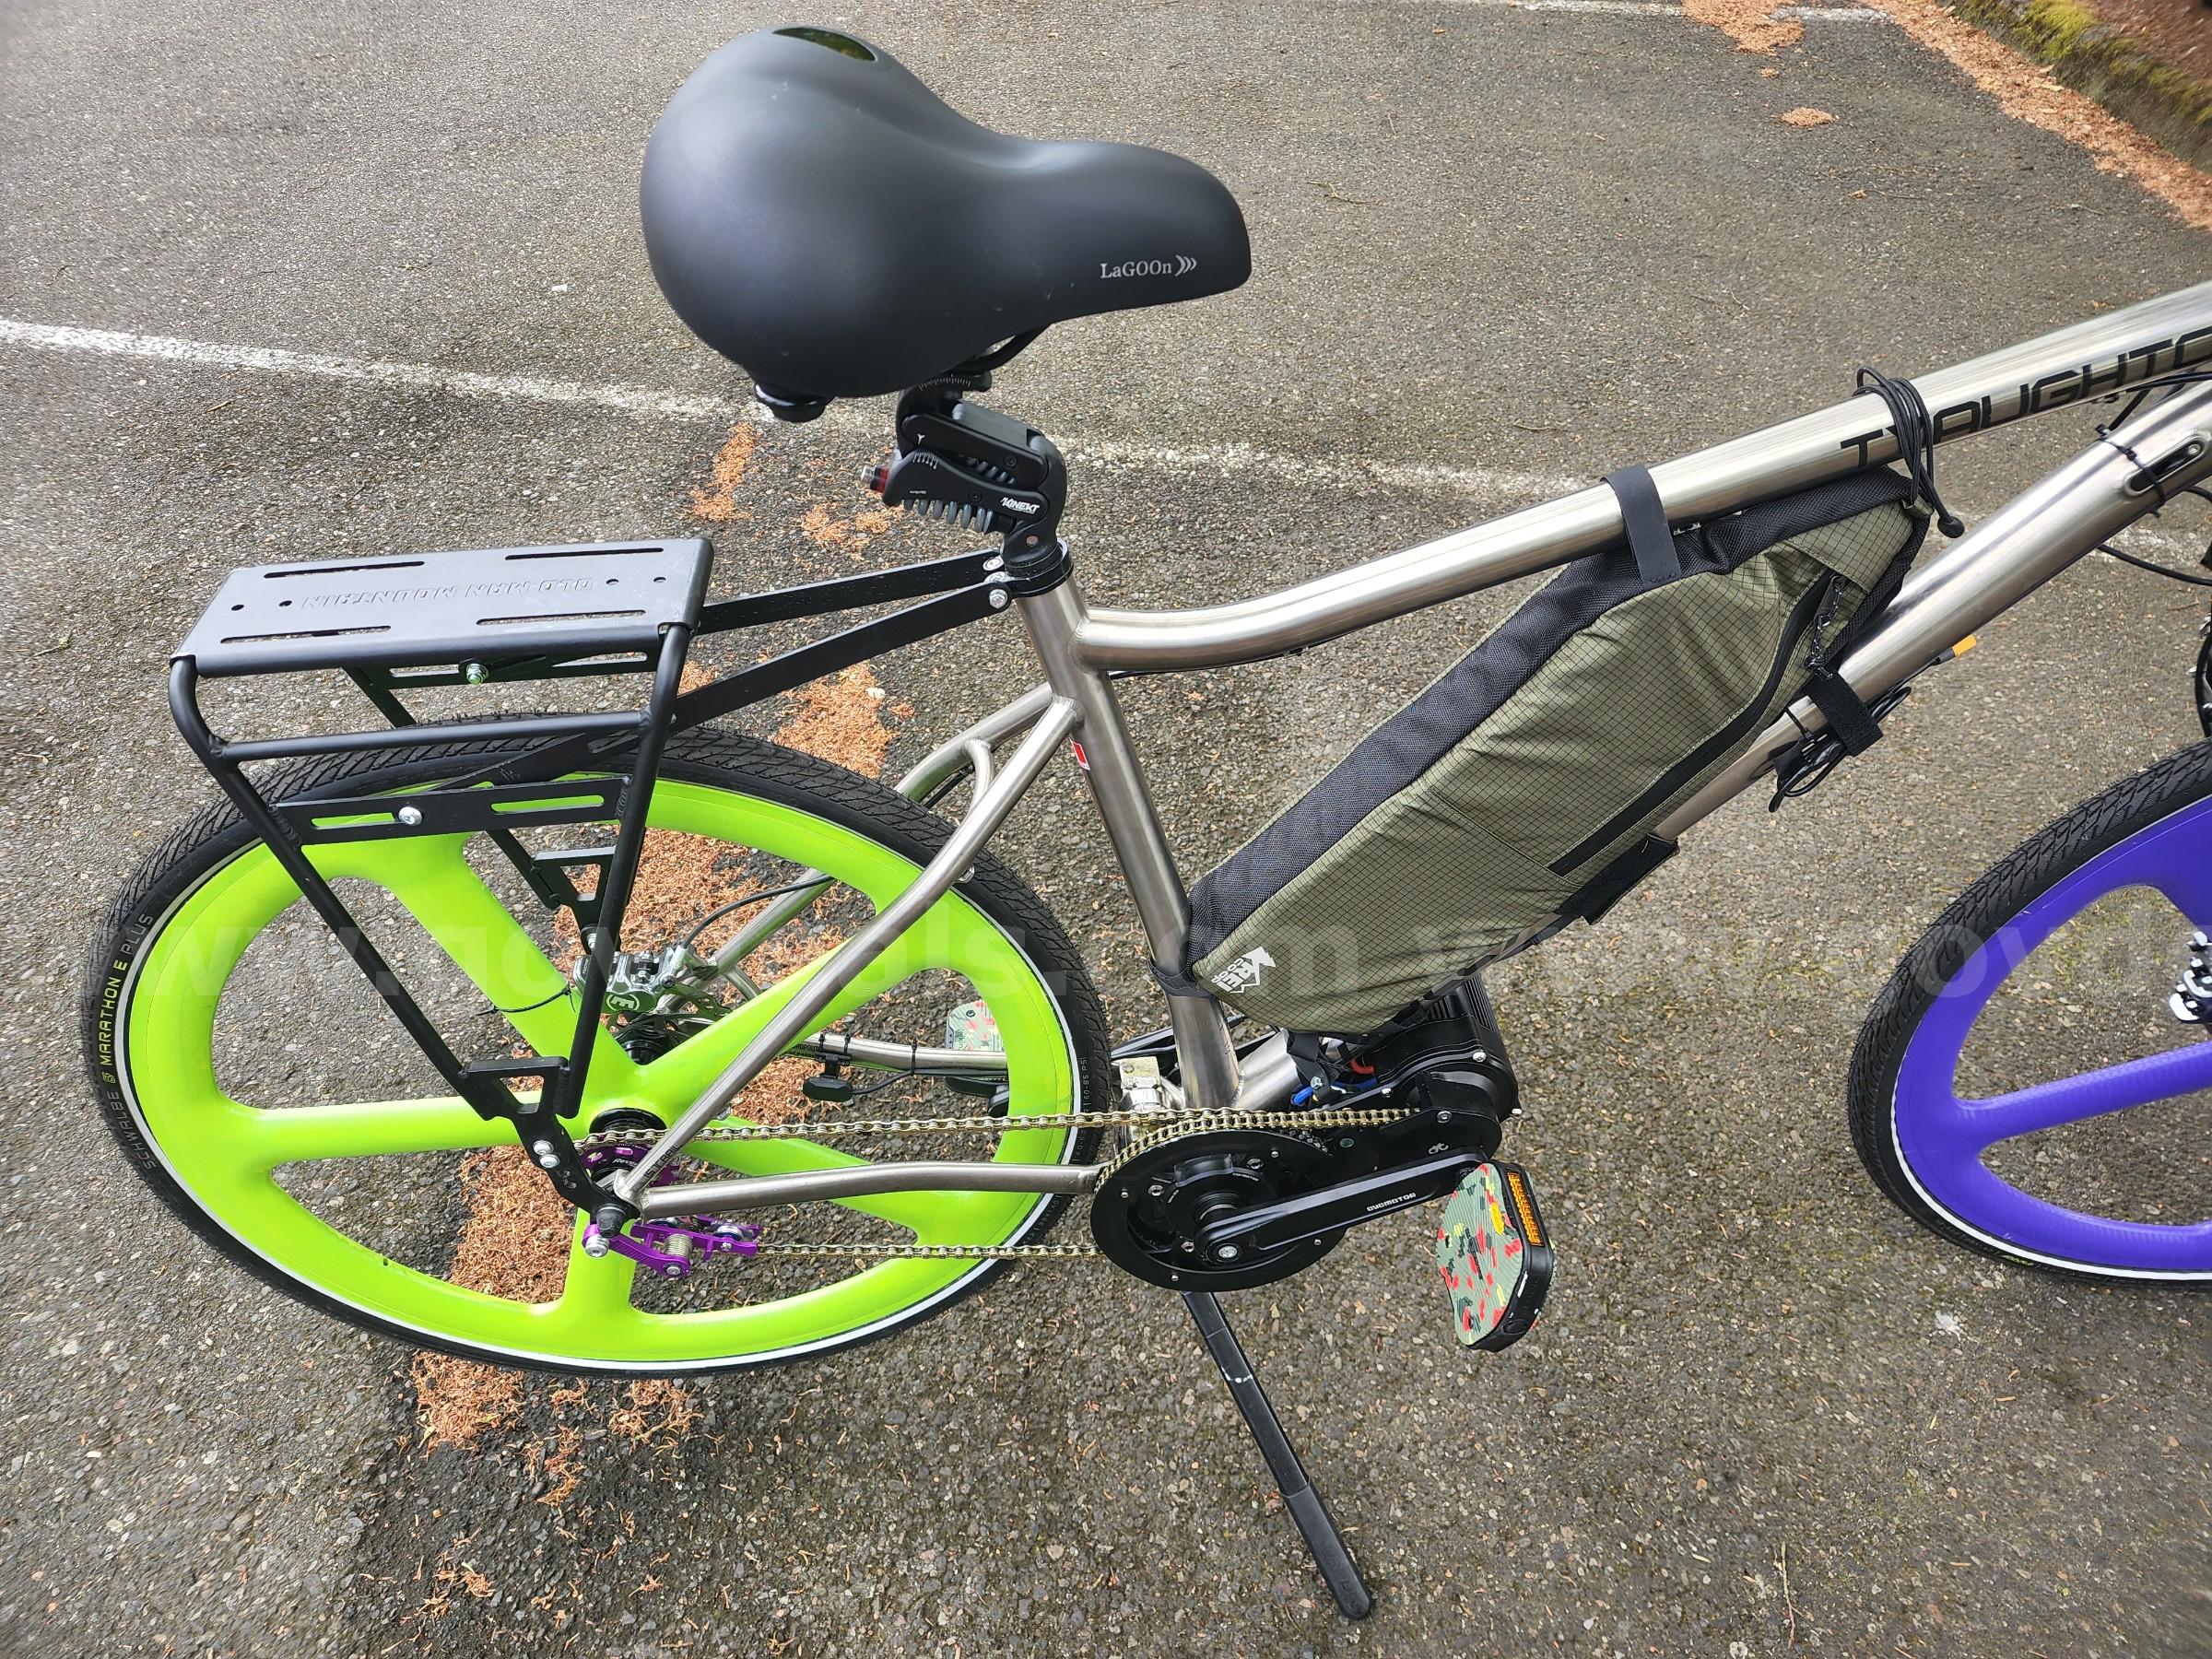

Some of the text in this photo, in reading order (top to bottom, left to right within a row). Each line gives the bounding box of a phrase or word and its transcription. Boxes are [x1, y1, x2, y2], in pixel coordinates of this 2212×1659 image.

[1100, 259, 1171, 278] LaGOOn
[301, 577, 594, 609] OLD MAN MOUNTAIN
[1216, 961, 1254, 993] REI
[99, 913, 158, 1170] SCHWALBE MARATHON E PLUS
